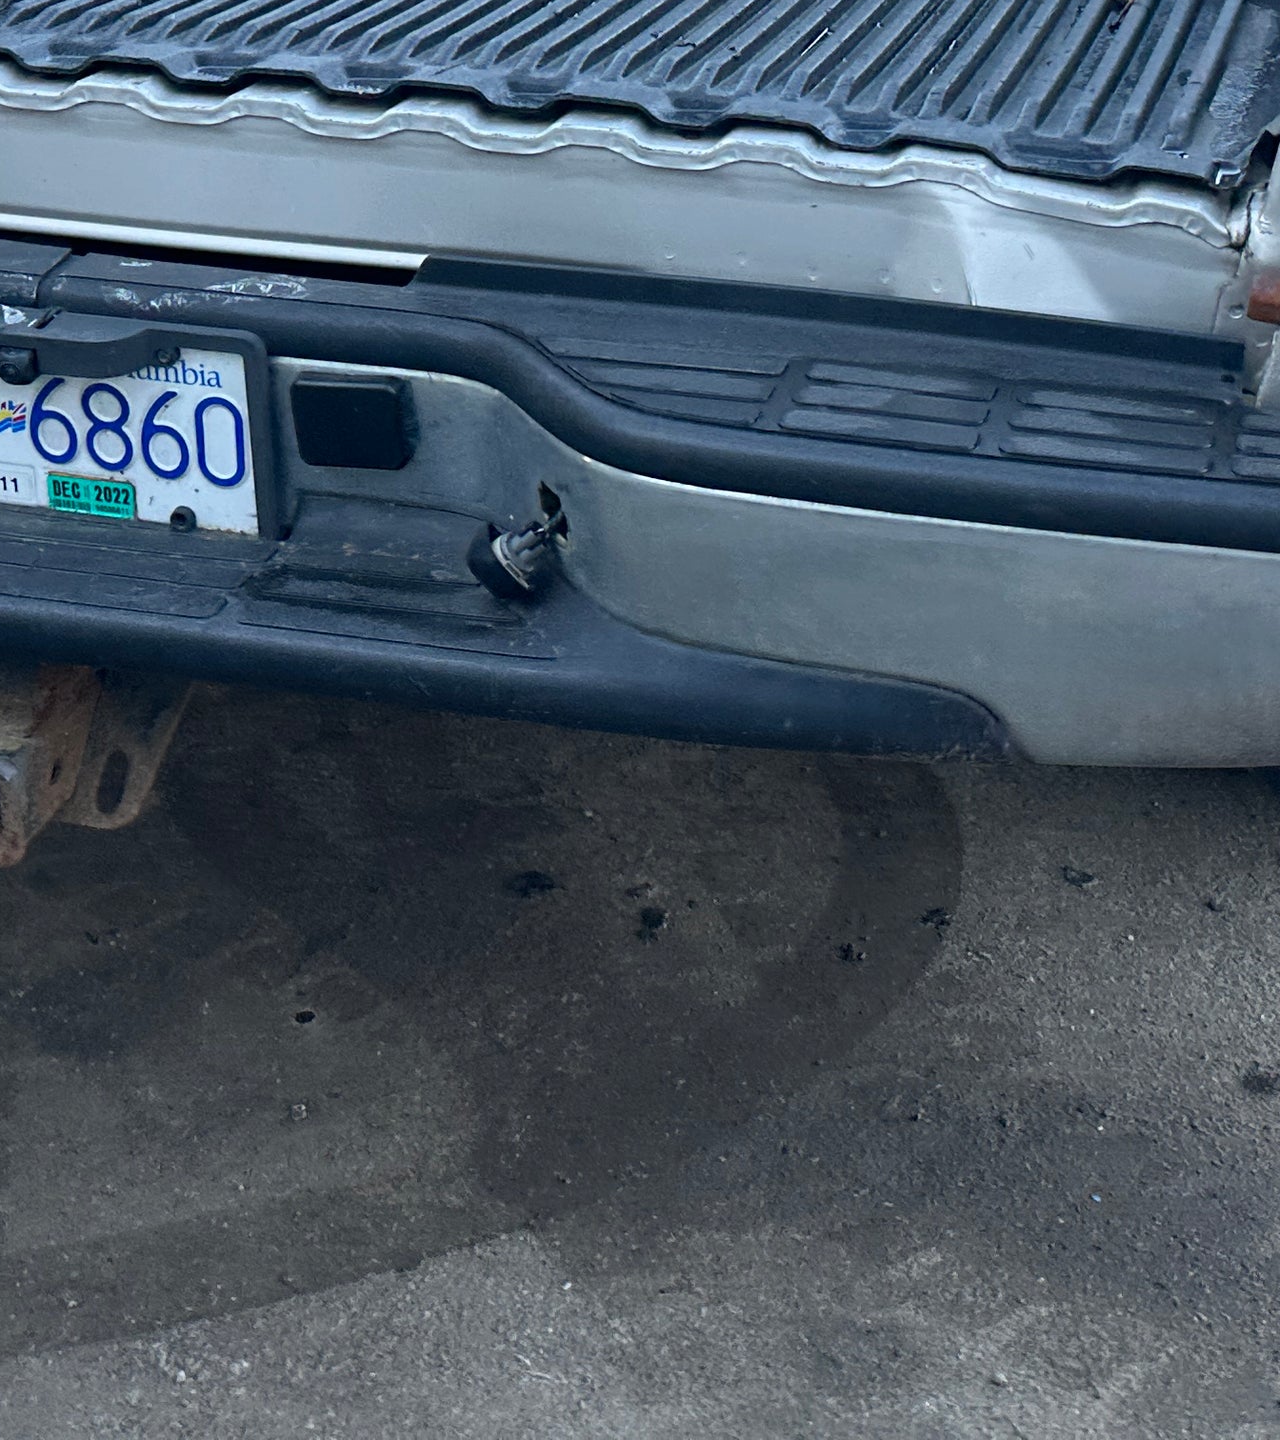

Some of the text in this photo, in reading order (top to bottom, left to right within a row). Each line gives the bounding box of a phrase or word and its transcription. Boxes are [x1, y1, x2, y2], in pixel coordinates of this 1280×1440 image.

[30, 377, 245, 487] 6860
[0, 476, 19, 493] 11
[52, 479, 131, 505] DEC 2022
